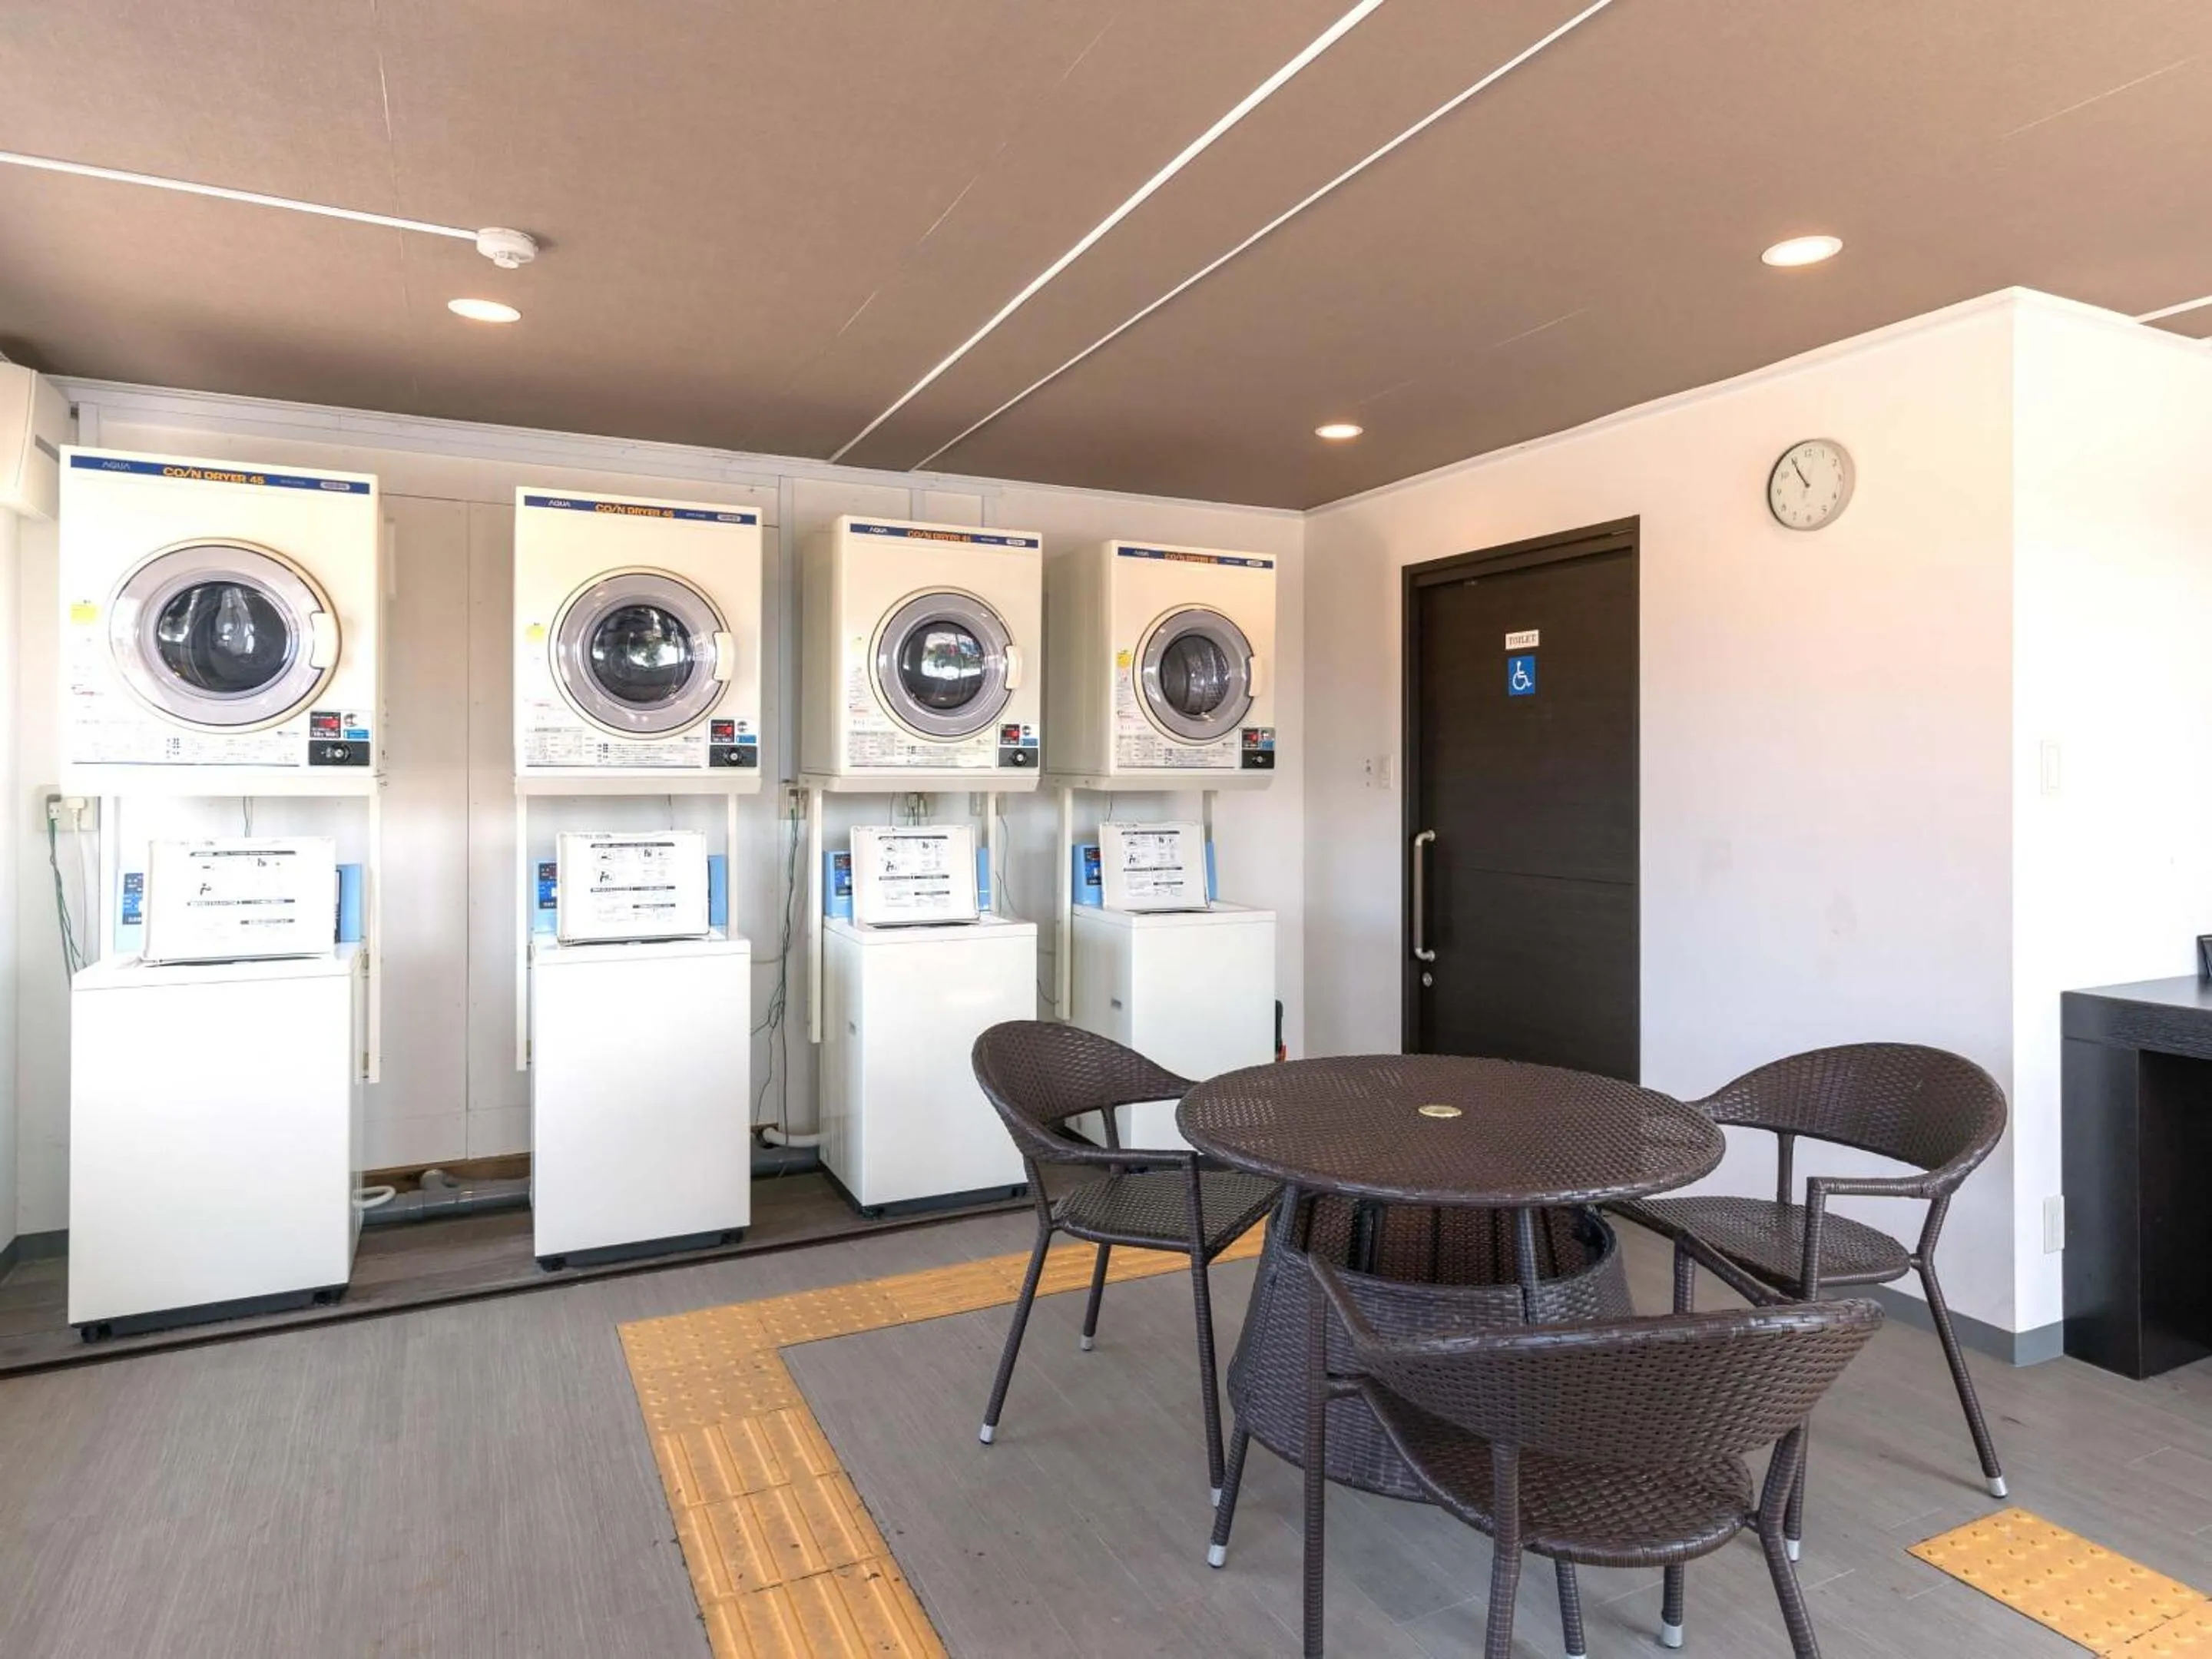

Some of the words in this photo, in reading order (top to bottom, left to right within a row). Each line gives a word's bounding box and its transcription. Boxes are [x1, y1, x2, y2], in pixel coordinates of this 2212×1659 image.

[101, 461, 131, 471] AQUA
[204, 471, 248, 483] DRYER
[250, 475, 265, 485] 45
[548, 499, 571, 508] AQUA
